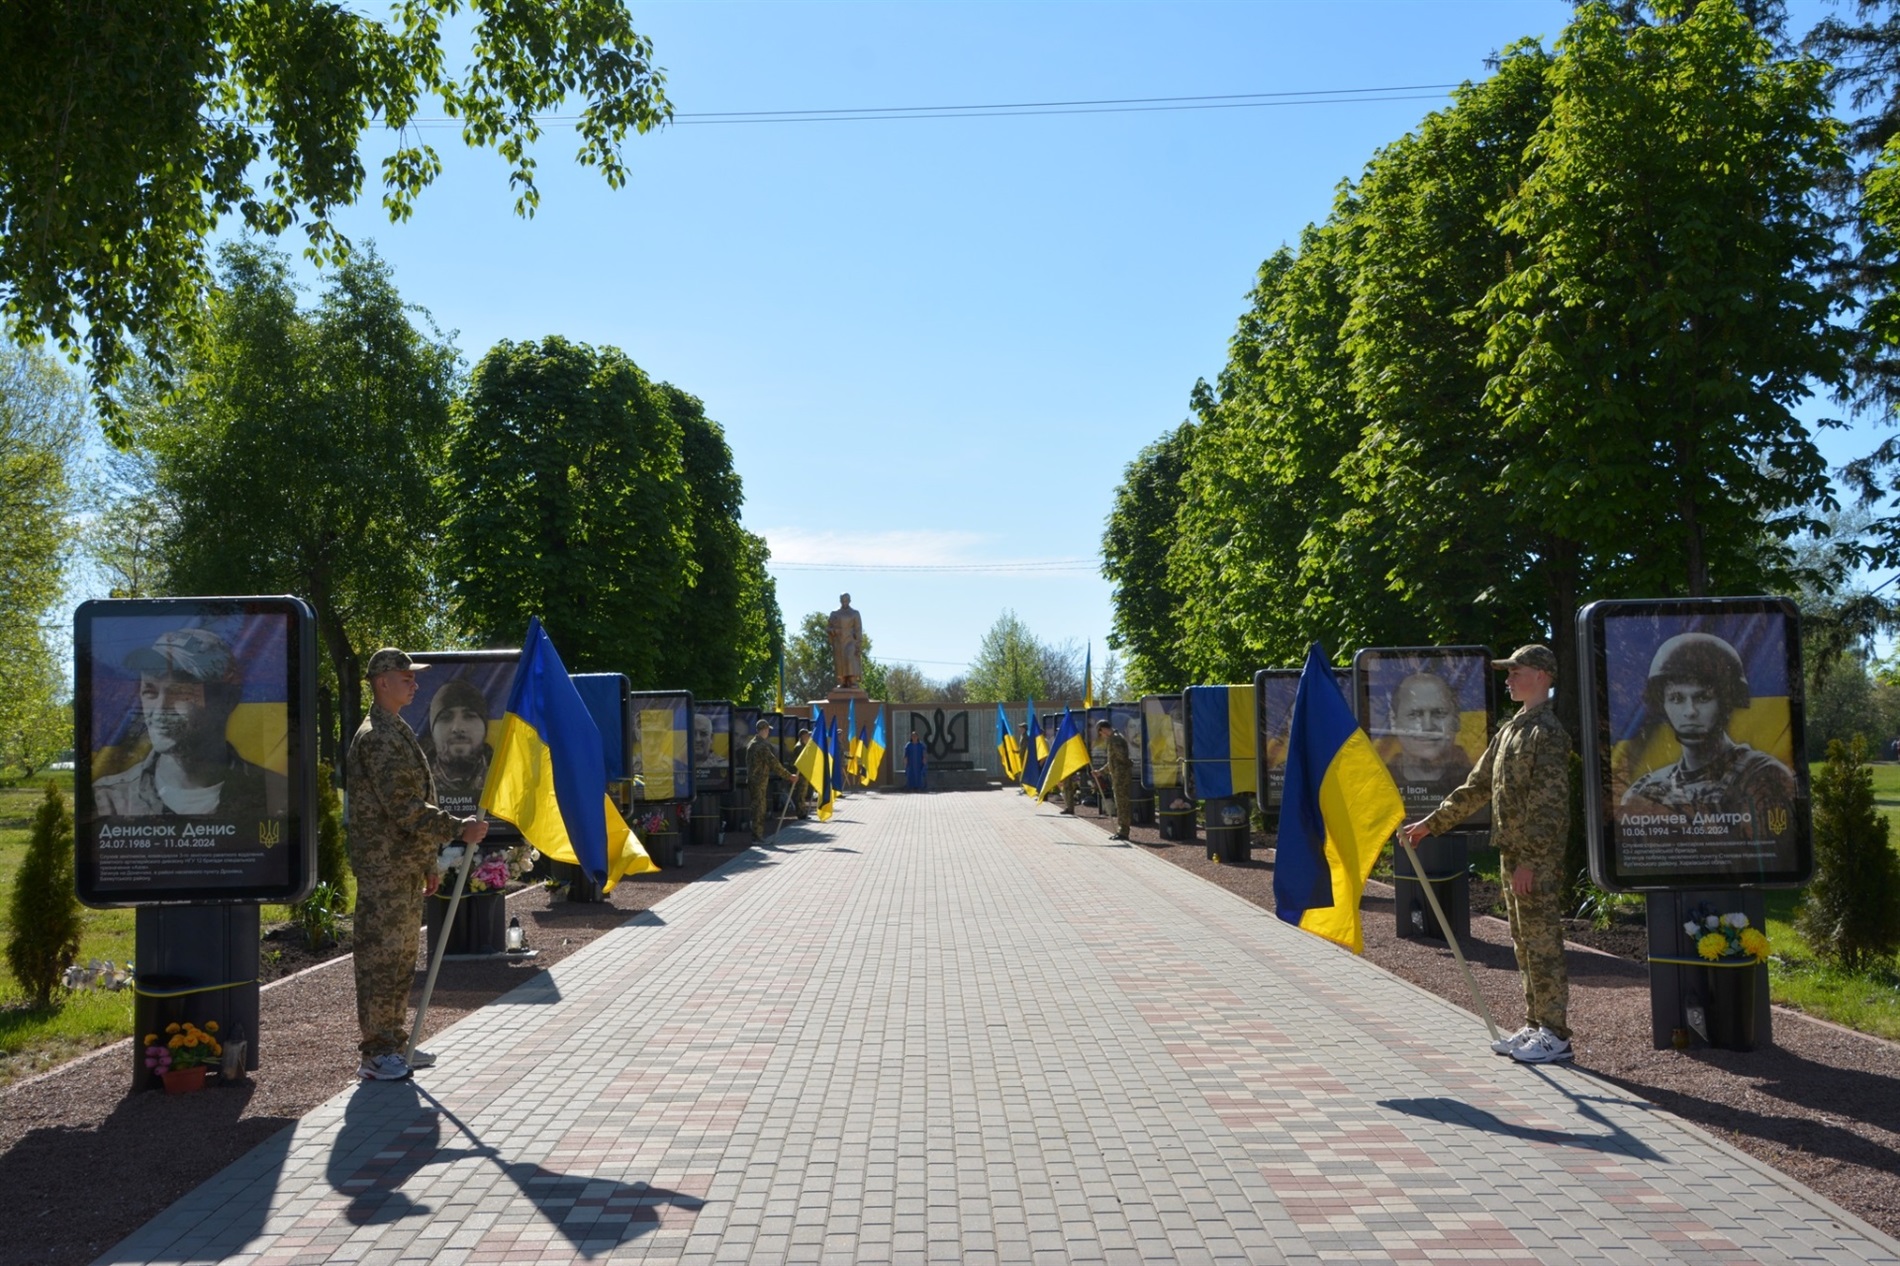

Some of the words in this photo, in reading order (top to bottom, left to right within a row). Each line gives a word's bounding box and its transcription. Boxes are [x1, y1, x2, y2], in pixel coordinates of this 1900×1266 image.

[1407, 785, 1427, 794] Іван
[439, 795, 473, 804] Вадим
[1620, 813, 1687, 827] Ларичев
[1692, 811, 1752, 826] Дмитро
[99, 823, 176, 839] Денисюк
[182, 822, 236, 838] Денис
[1622, 827, 1669, 836] 10.06.1994
[1681, 826, 1729, 835] 14.05.2024
[99, 839, 151, 849] 24.07.1988
[164, 838, 215, 848] 11.04.2024
